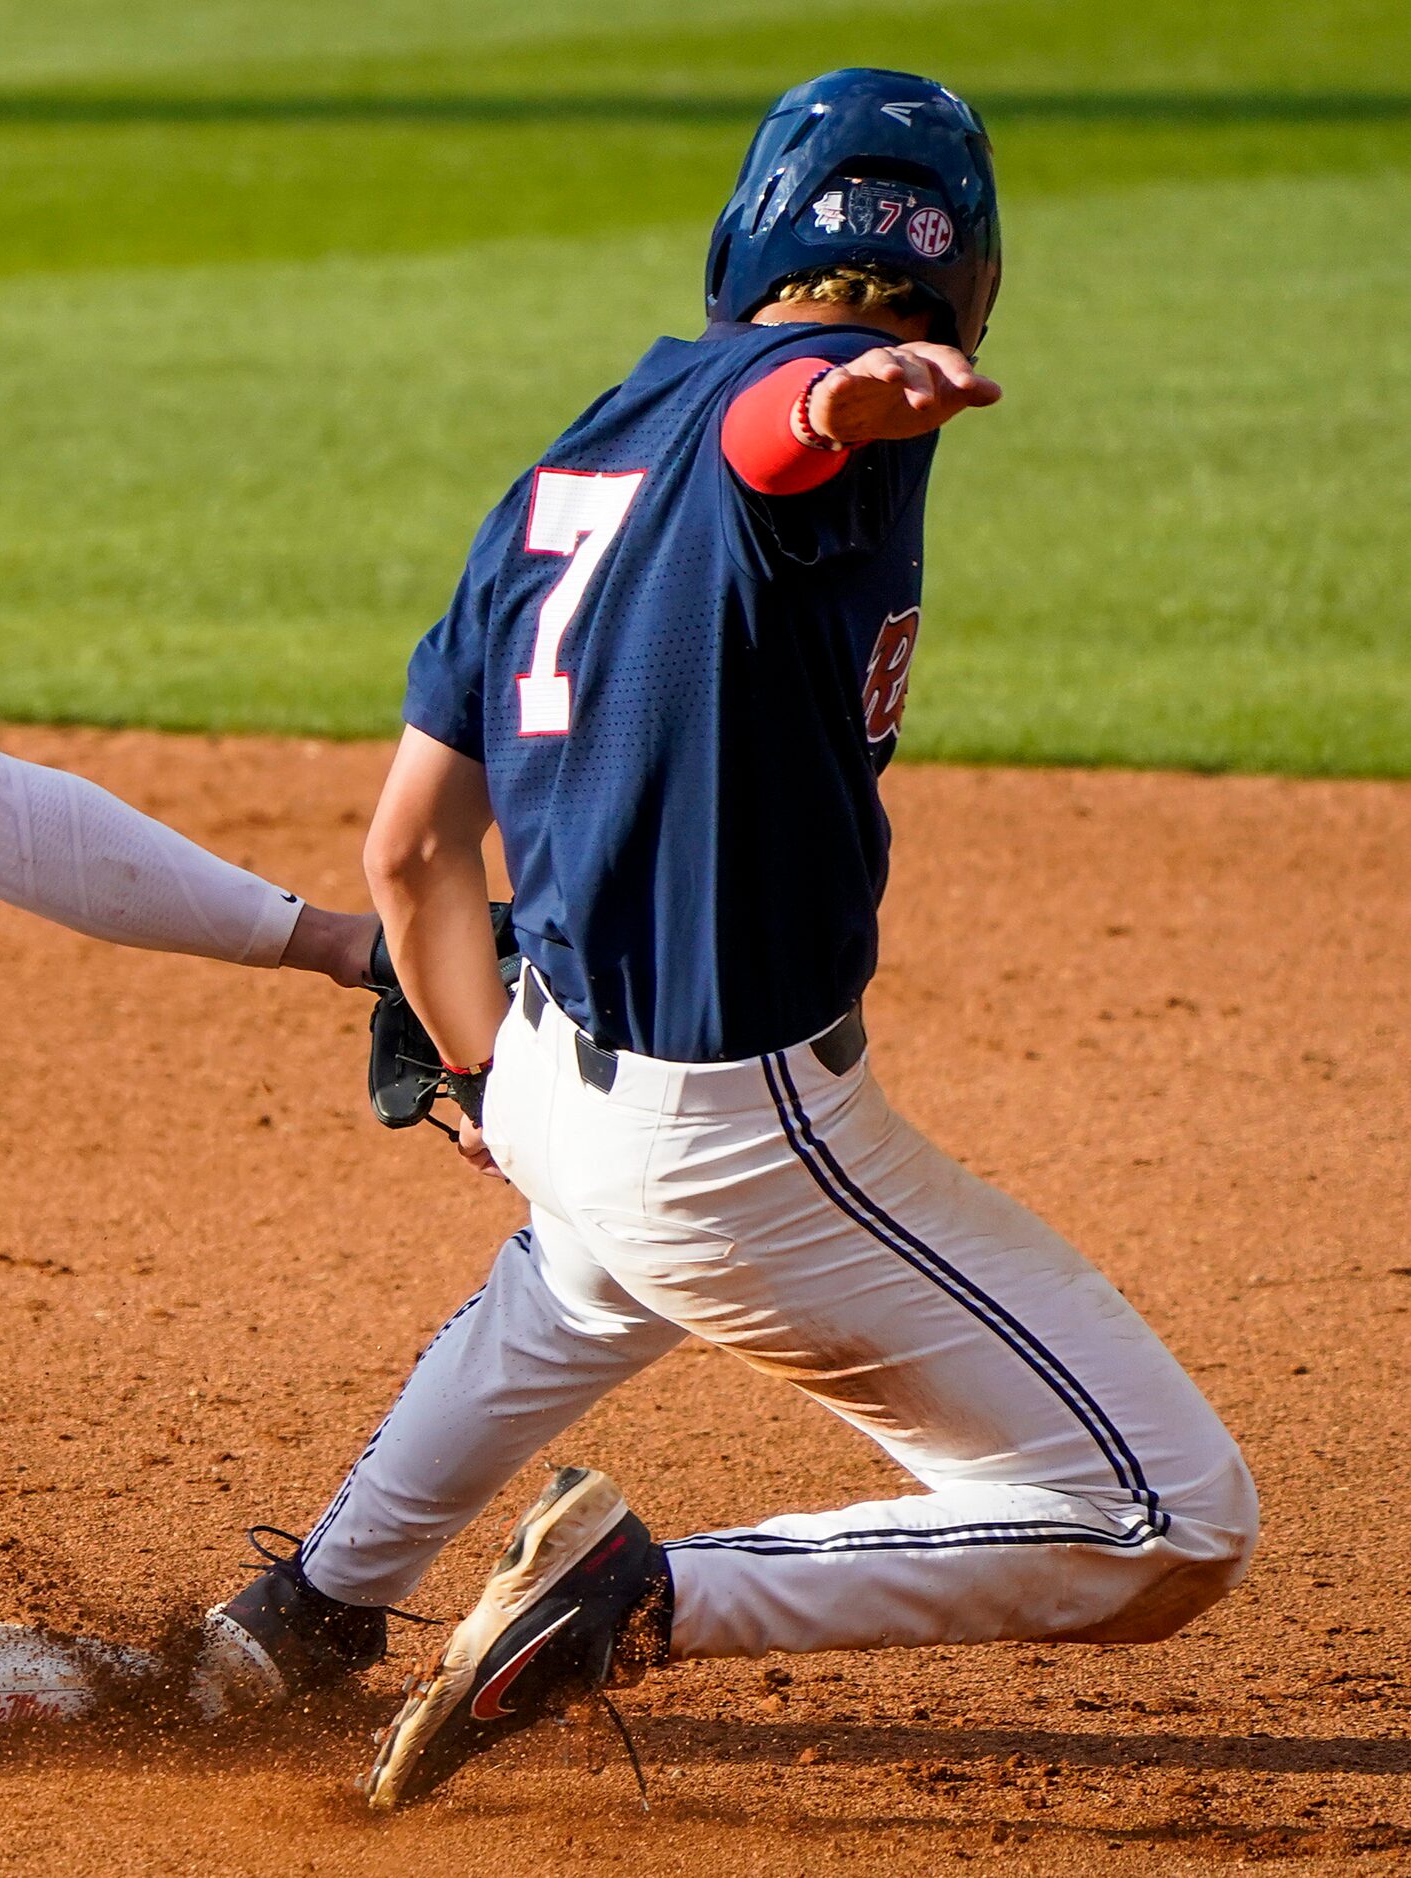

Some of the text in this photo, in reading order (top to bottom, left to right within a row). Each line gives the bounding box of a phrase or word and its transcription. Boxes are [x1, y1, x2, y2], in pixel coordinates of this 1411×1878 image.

[876, 200, 902, 234] 7
[911, 209, 950, 254] SEC
[514, 465, 648, 737] 7
